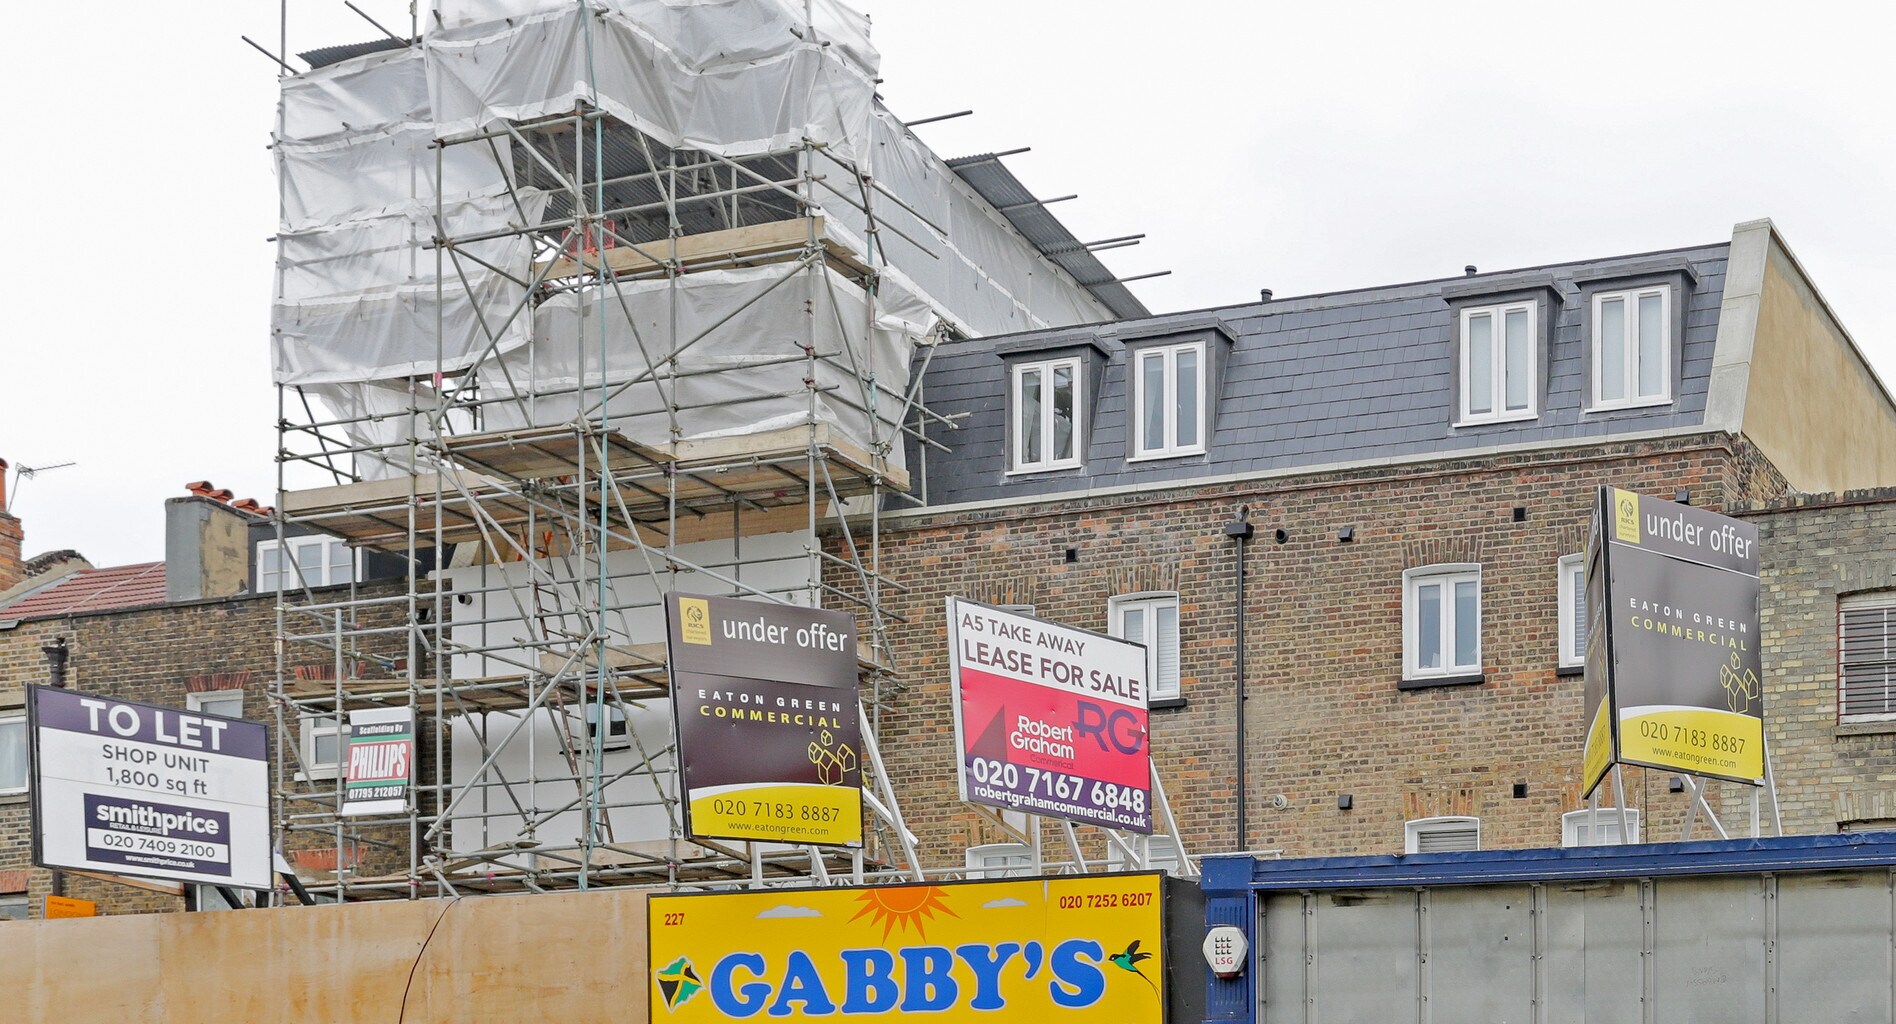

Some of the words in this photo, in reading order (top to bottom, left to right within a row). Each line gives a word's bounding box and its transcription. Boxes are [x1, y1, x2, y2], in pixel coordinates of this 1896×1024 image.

[1647, 512, 1704, 546] under
[1710, 524, 1752, 560] offer
[1630, 598, 1683, 619] EATON
[1693, 612, 1748, 633] GREEN
[723, 617, 788, 644] under
[796, 623, 847, 651] offer
[961, 612, 983, 632] A5
[988, 619, 1031, 644] TAKE
[1037, 632, 1085, 657] AWAY
[1631, 615, 1747, 651] COMMERCIAL
[964, 639, 1033, 676] LEASE
[1040, 657, 1084, 687] FOR
[1090, 670, 1140, 700] SALE
[699, 689, 764, 704] EATON
[777, 698, 840, 712] GREEN
[80, 698, 141, 737] TO
[154, 711, 228, 751] LET
[360, 725, 394, 734] Scaffolding
[700, 705, 840, 729] COMMERCIAL
[1017, 715, 1074, 743] Robert
[1072, 700, 1144, 755] RG
[1011, 731, 1075, 760] Graham
[1640, 720, 1668, 741] 020
[1674, 726, 1707, 748] 7183
[1712, 733, 1746, 755] 8887
[102, 744, 157, 765] SHOP
[164, 752, 209, 773] UNIT
[350, 743, 407, 780] PHILLIPS
[1652, 746, 1737, 769] www.eatongreen.com
[106, 767, 159, 787] 1,800
[166, 778, 187, 795] sq
[193, 780, 207, 795] ft
[349, 788, 372, 799] 07795
[374, 786, 403, 798] 212057
[973, 757, 1018, 789] 020
[1026, 767, 1084, 800] 7167
[1090, 781, 1145, 813] 6848
[96, 803, 219, 836] smithprice
[714, 799, 746, 815] 020
[754, 802, 794, 819] 7183
[801, 806, 840, 822] 8887
[974, 785, 1146, 828] robertgrahamcommercial.co.uk
[109, 822, 131, 831] RETAIL
[728, 822, 829, 835] www.eatongreen.com
[103, 834, 134, 848] 020
[138, 838, 176, 853] 7409
[180, 843, 215, 858] 2100
[125, 854, 195, 868] www.smithprice.co.uk
[1059, 895, 1083, 910] 020
[1086, 894, 1120, 908] 7252
[1122, 892, 1153, 907] 6207
[664, 913, 685, 926] 227
[1215, 957, 1233, 965] LSG
[709, 938, 1107, 1019] GABBY'S
